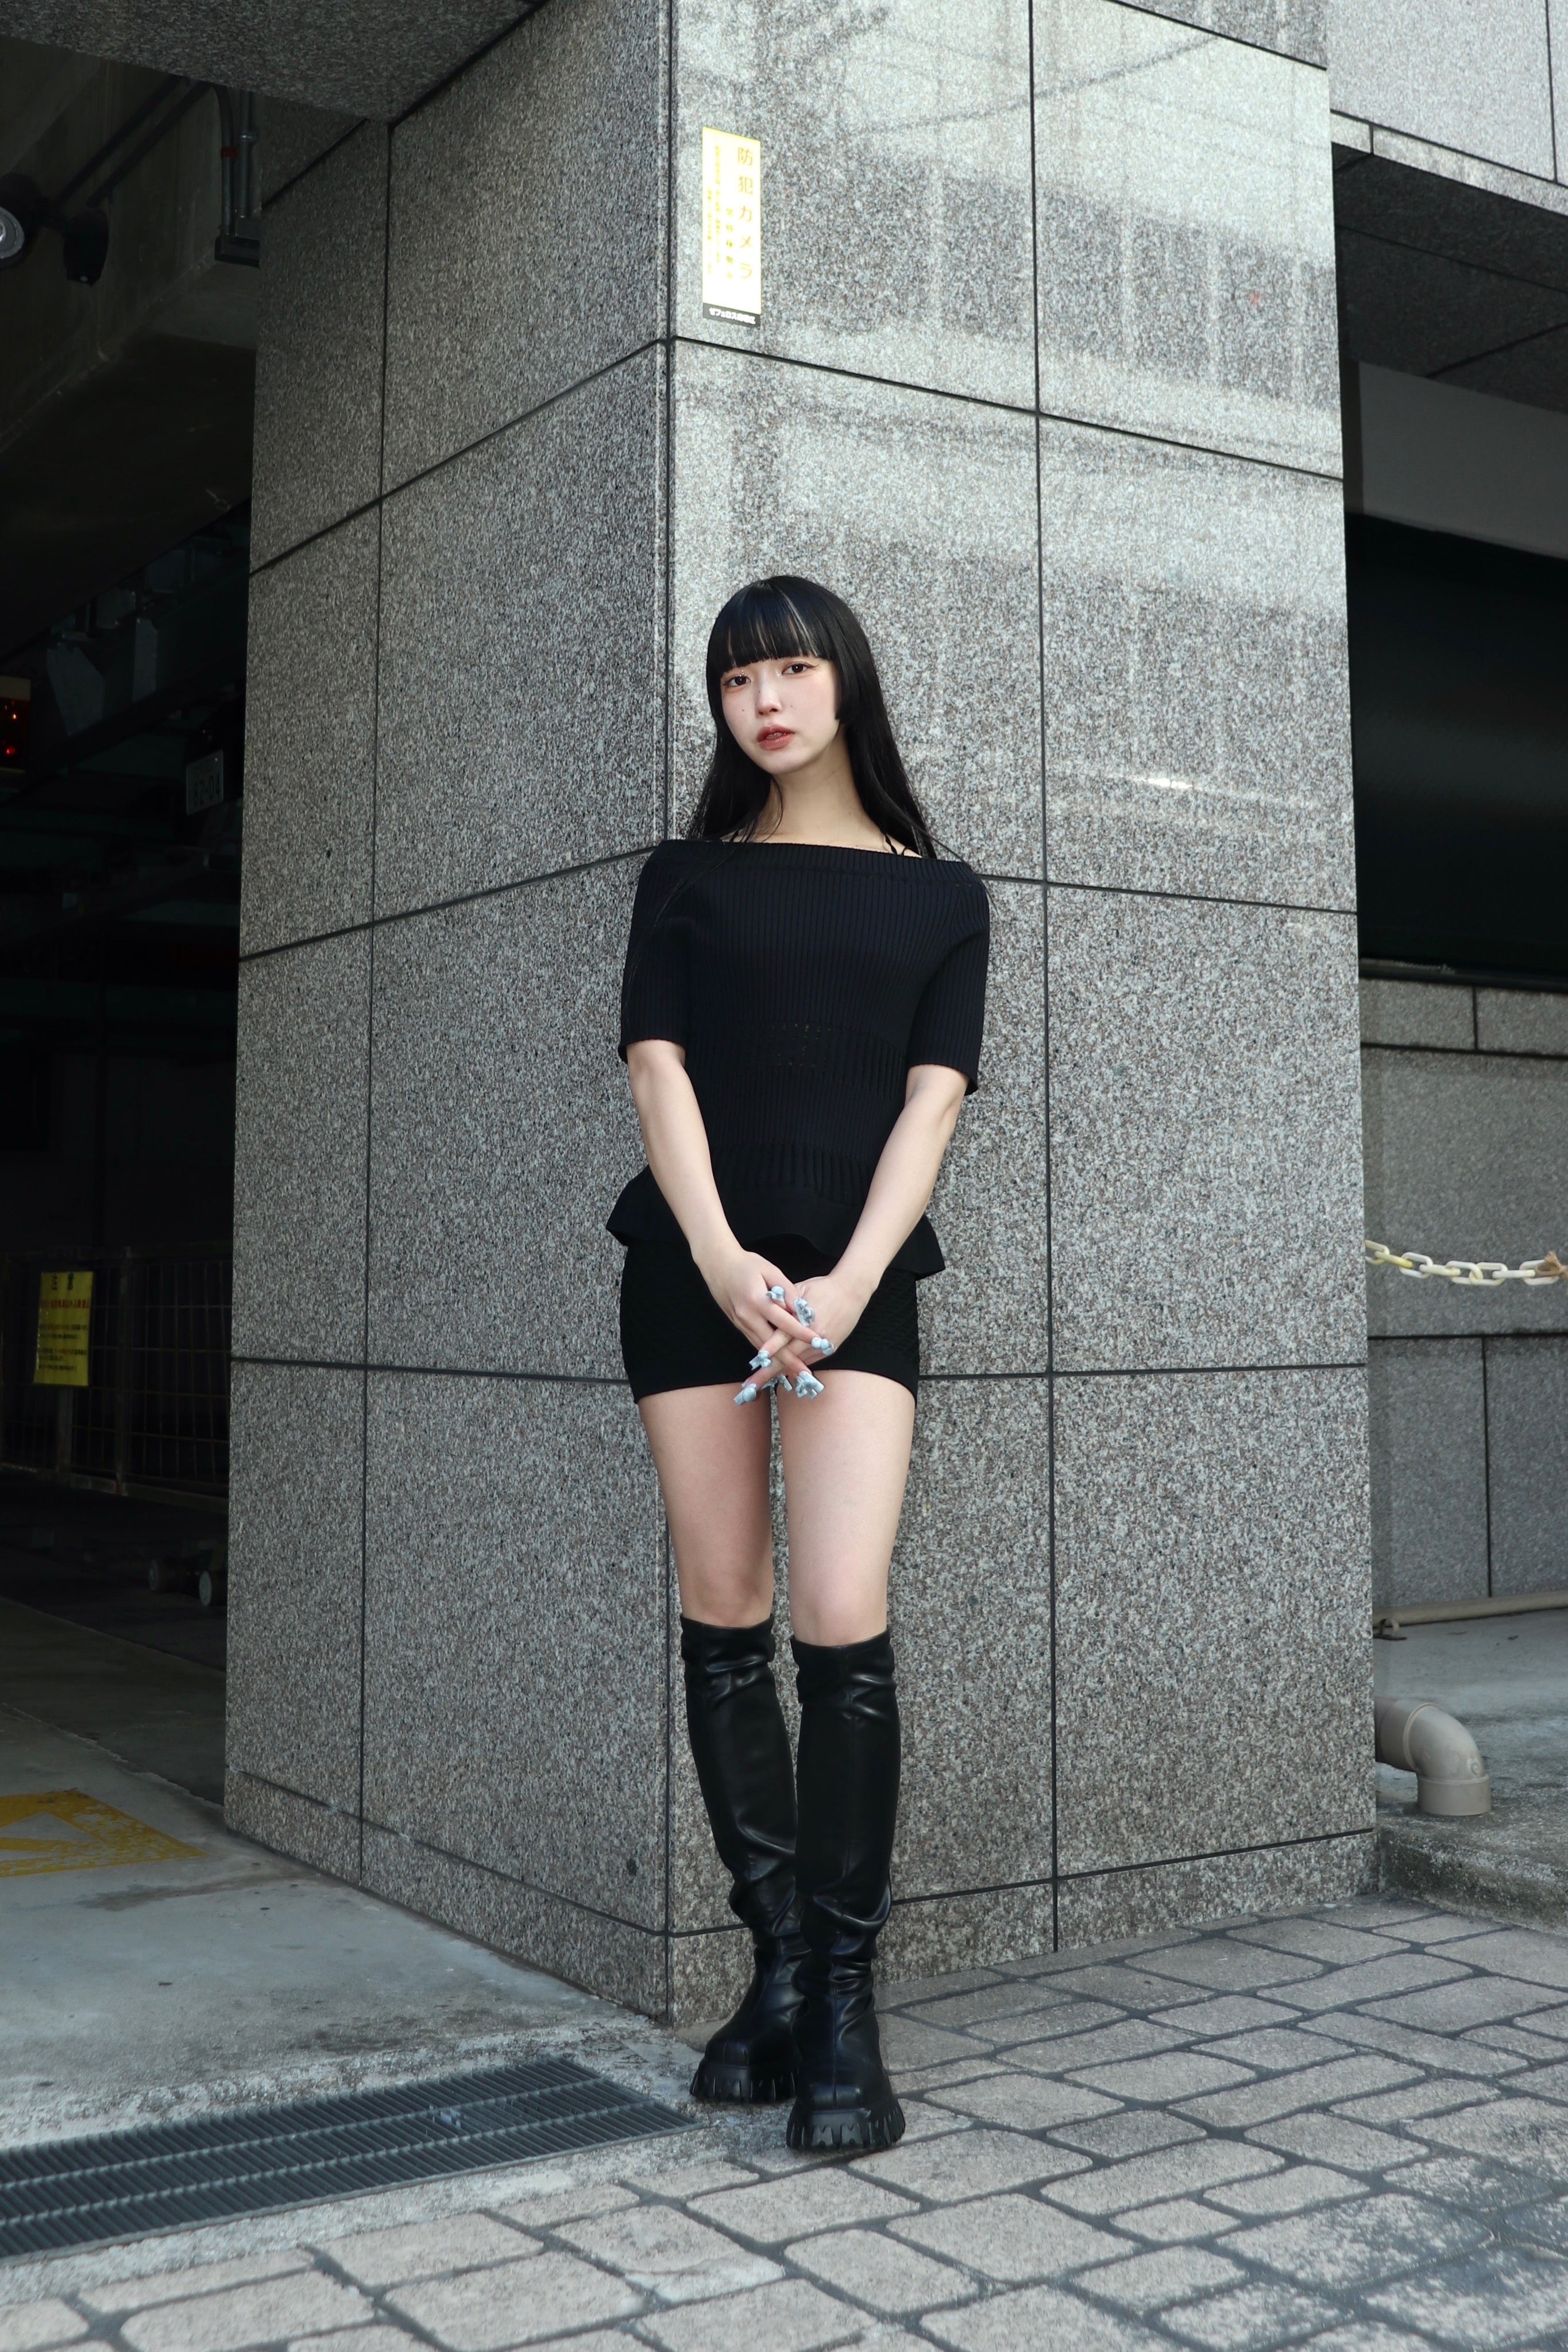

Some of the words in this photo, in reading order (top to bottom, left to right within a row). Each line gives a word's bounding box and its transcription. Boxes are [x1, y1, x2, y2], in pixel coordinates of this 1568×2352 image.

[737, 147, 754, 279] 防犯カメラ
